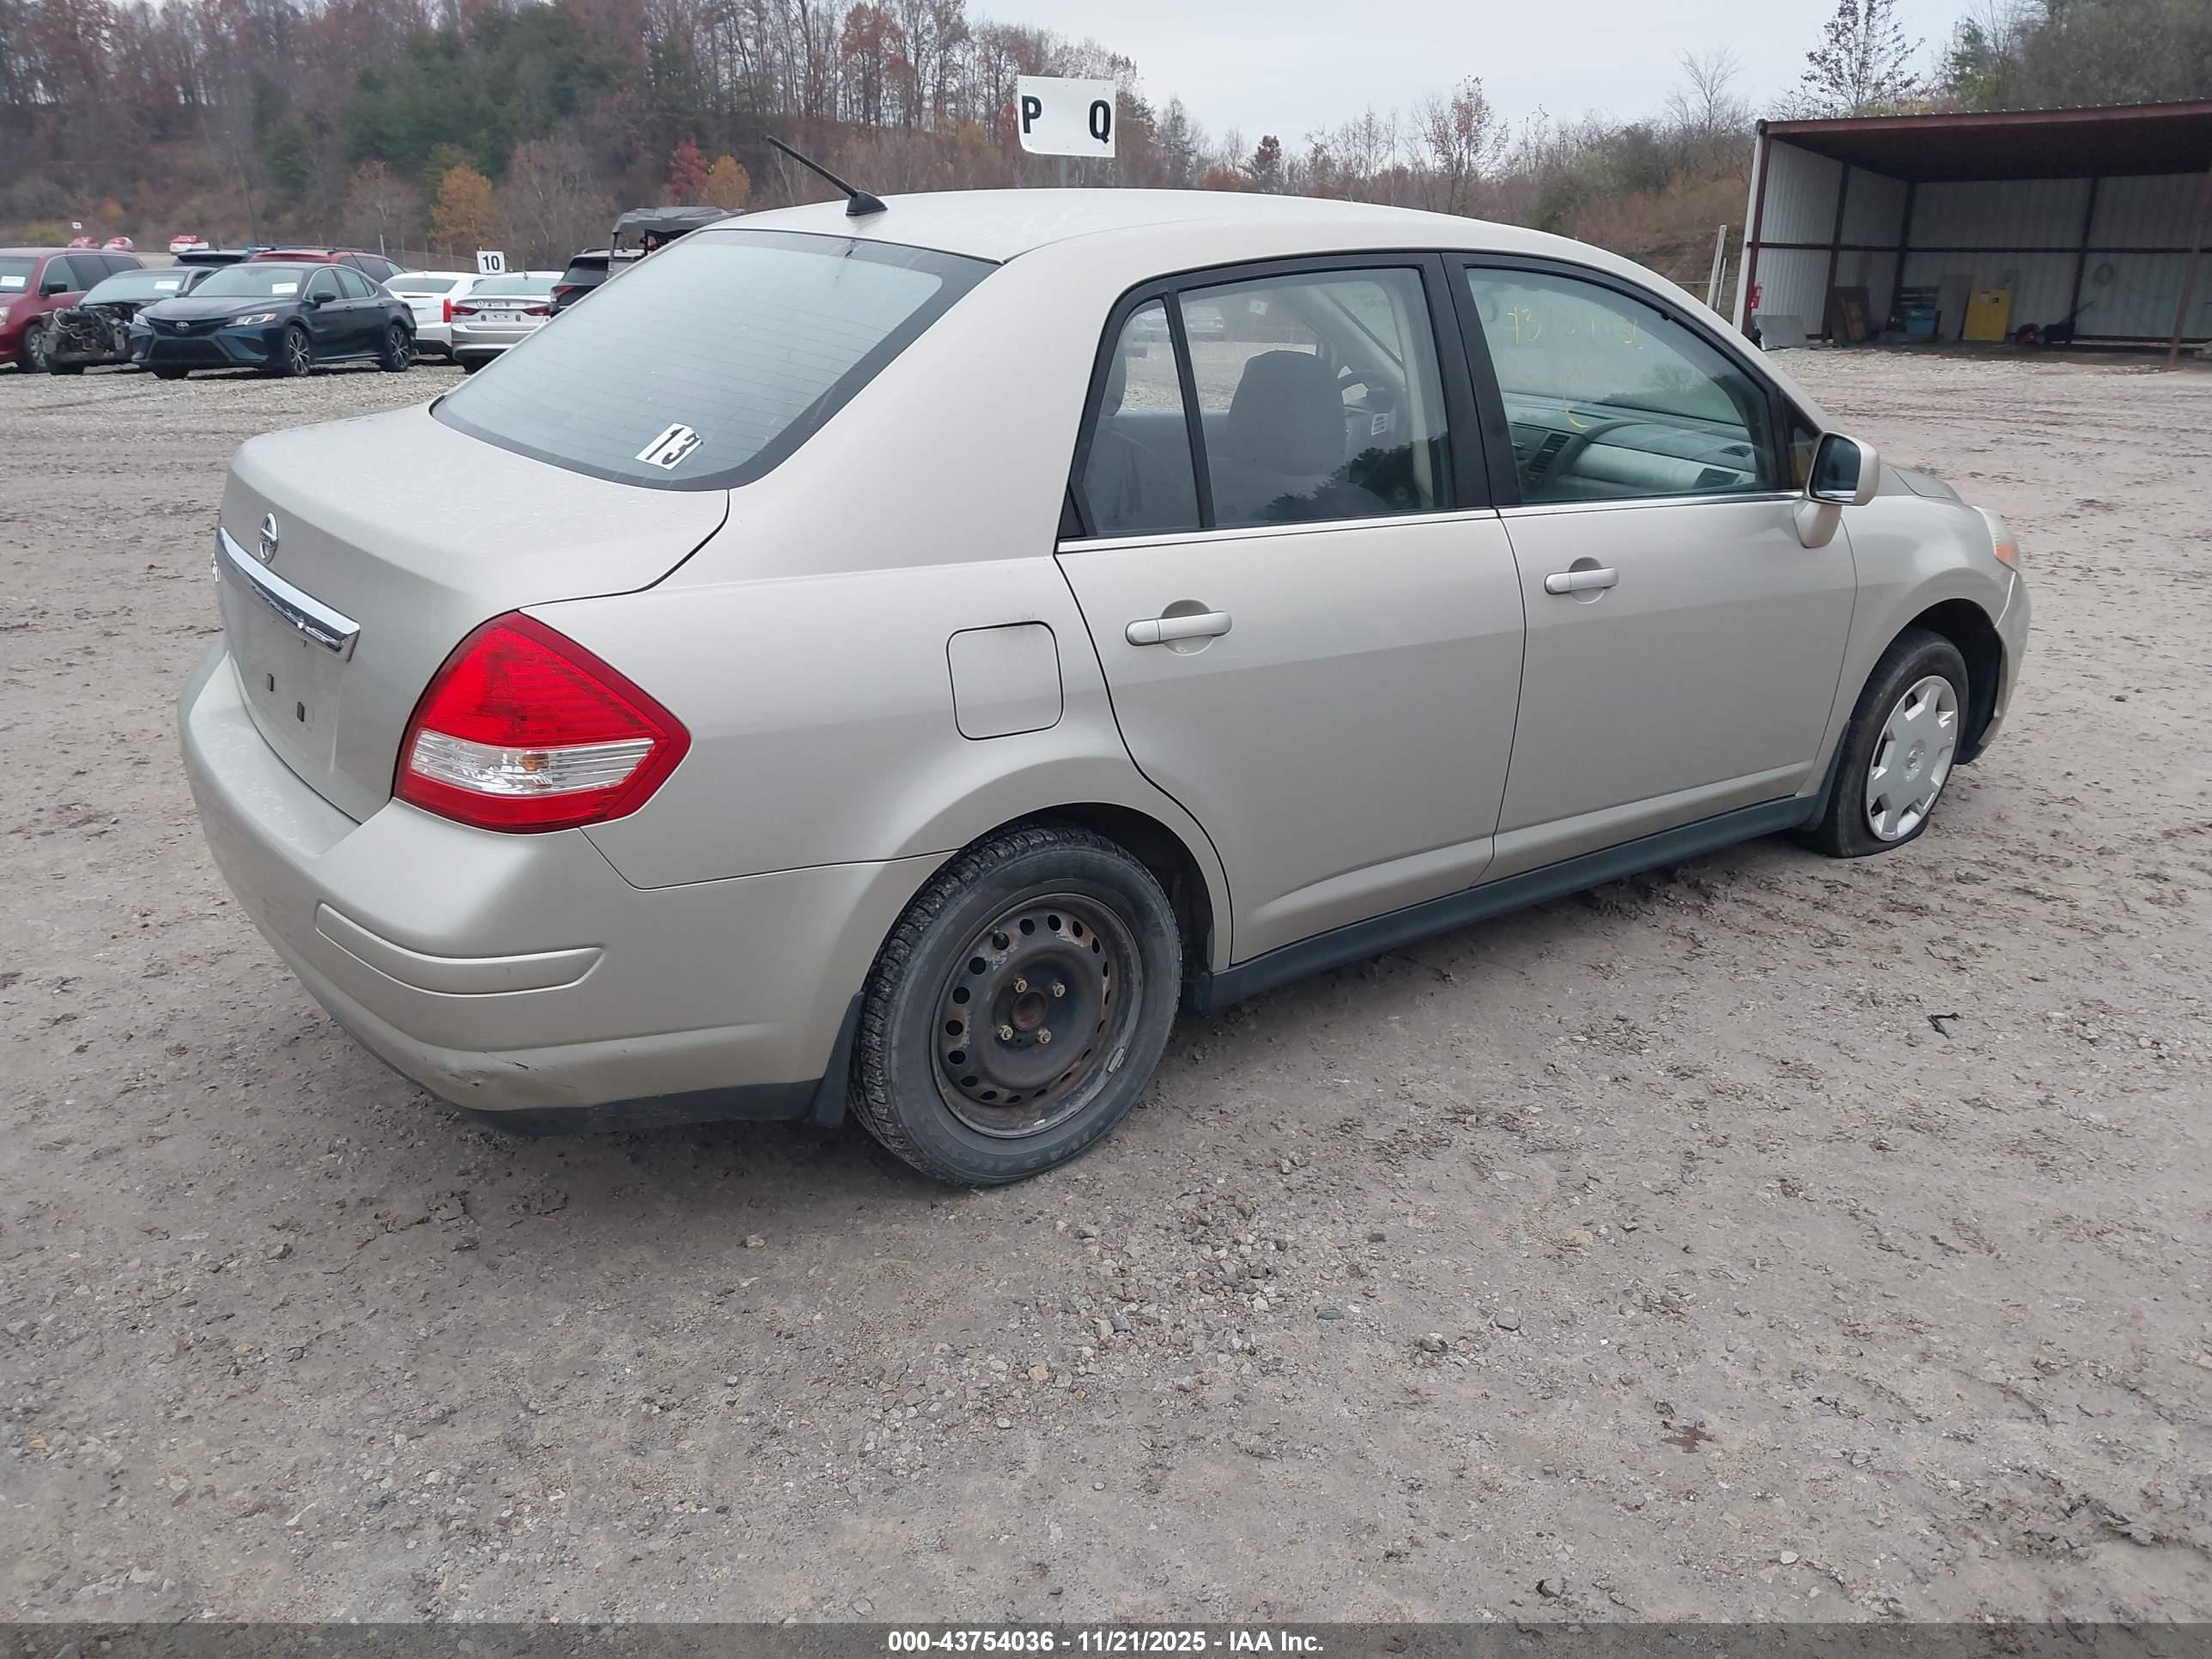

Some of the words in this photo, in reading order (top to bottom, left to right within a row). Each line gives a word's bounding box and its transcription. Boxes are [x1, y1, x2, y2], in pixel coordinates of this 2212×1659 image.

[1022, 95, 1042, 134] P
[1089, 100, 1110, 144] Q
[482, 255, 500, 270] 10
[645, 427, 700, 465] 13
